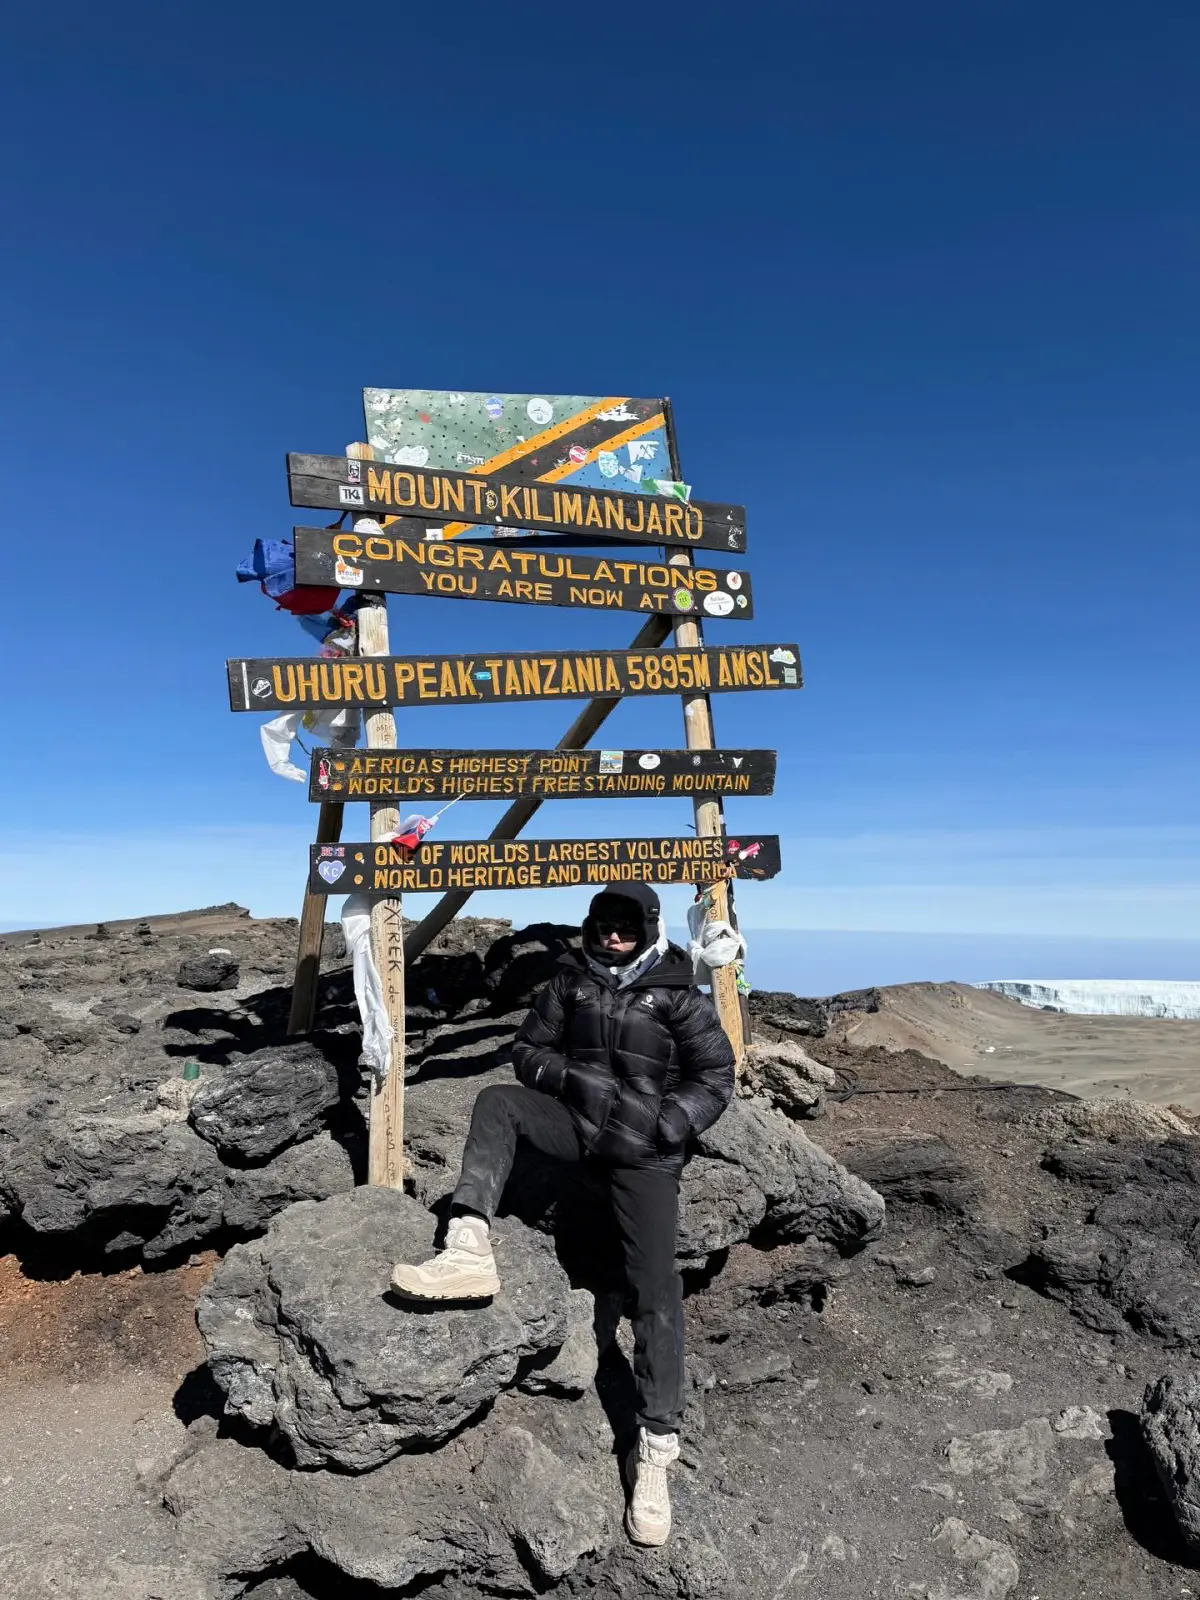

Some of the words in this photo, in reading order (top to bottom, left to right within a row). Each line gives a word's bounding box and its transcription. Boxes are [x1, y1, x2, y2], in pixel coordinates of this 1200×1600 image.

[367, 468, 487, 515] MOUNT
[500, 484, 703, 540] KILIMANJARO
[332, 534, 718, 592] CONGRATULATIONS
[420, 571, 478, 594] YOU
[497, 579, 552, 601] ARE
[570, 586, 623, 607] NOW
[640, 592, 669, 610] AT
[272, 663, 387, 703] UHURU
[484, 655, 625, 695] TANZANIA,
[626, 653, 711, 690] 5895M
[718, 650, 780, 686] AMSL
[450, 758, 531, 773] HIGHEST
[540, 758, 590, 773] POINT
[349, 776, 435, 795] WORLD'S
[442, 776, 528, 794] HIGHEST
[672, 774, 750, 791] MOUNTAIN
[421, 844, 445, 865] OF
[451, 843, 529, 864] WORLD'S
[534, 841, 621, 862] LARGEST
[626, 839, 723, 860] VOLCANOES
[374, 869, 443, 889] WORLD
[448, 865, 541, 887] HERITAGE
[547, 864, 581, 884] AND
[587, 863, 653, 882] WONDER
[658, 861, 677, 880] OF
[681, 860, 737, 880] AFRICA
